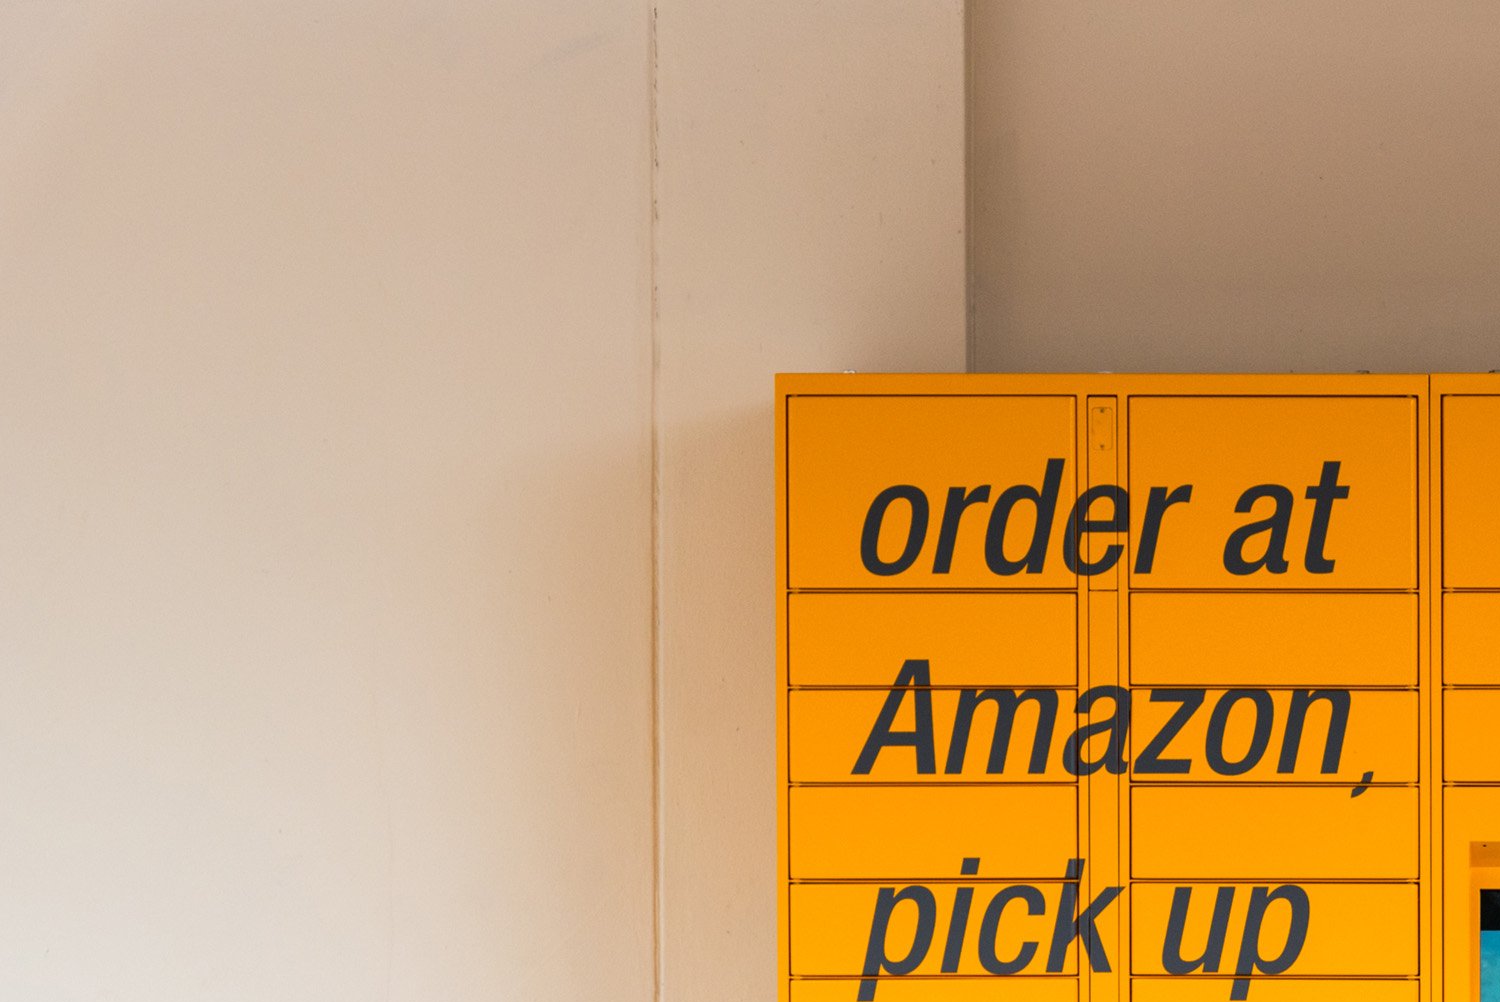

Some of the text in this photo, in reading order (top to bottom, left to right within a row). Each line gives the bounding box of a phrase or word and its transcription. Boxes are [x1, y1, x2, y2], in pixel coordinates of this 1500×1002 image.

[861, 458, 1351, 577] order at
[851, 659, 1375, 799] Amazon,
[857, 857, 1311, 1002] pick up
